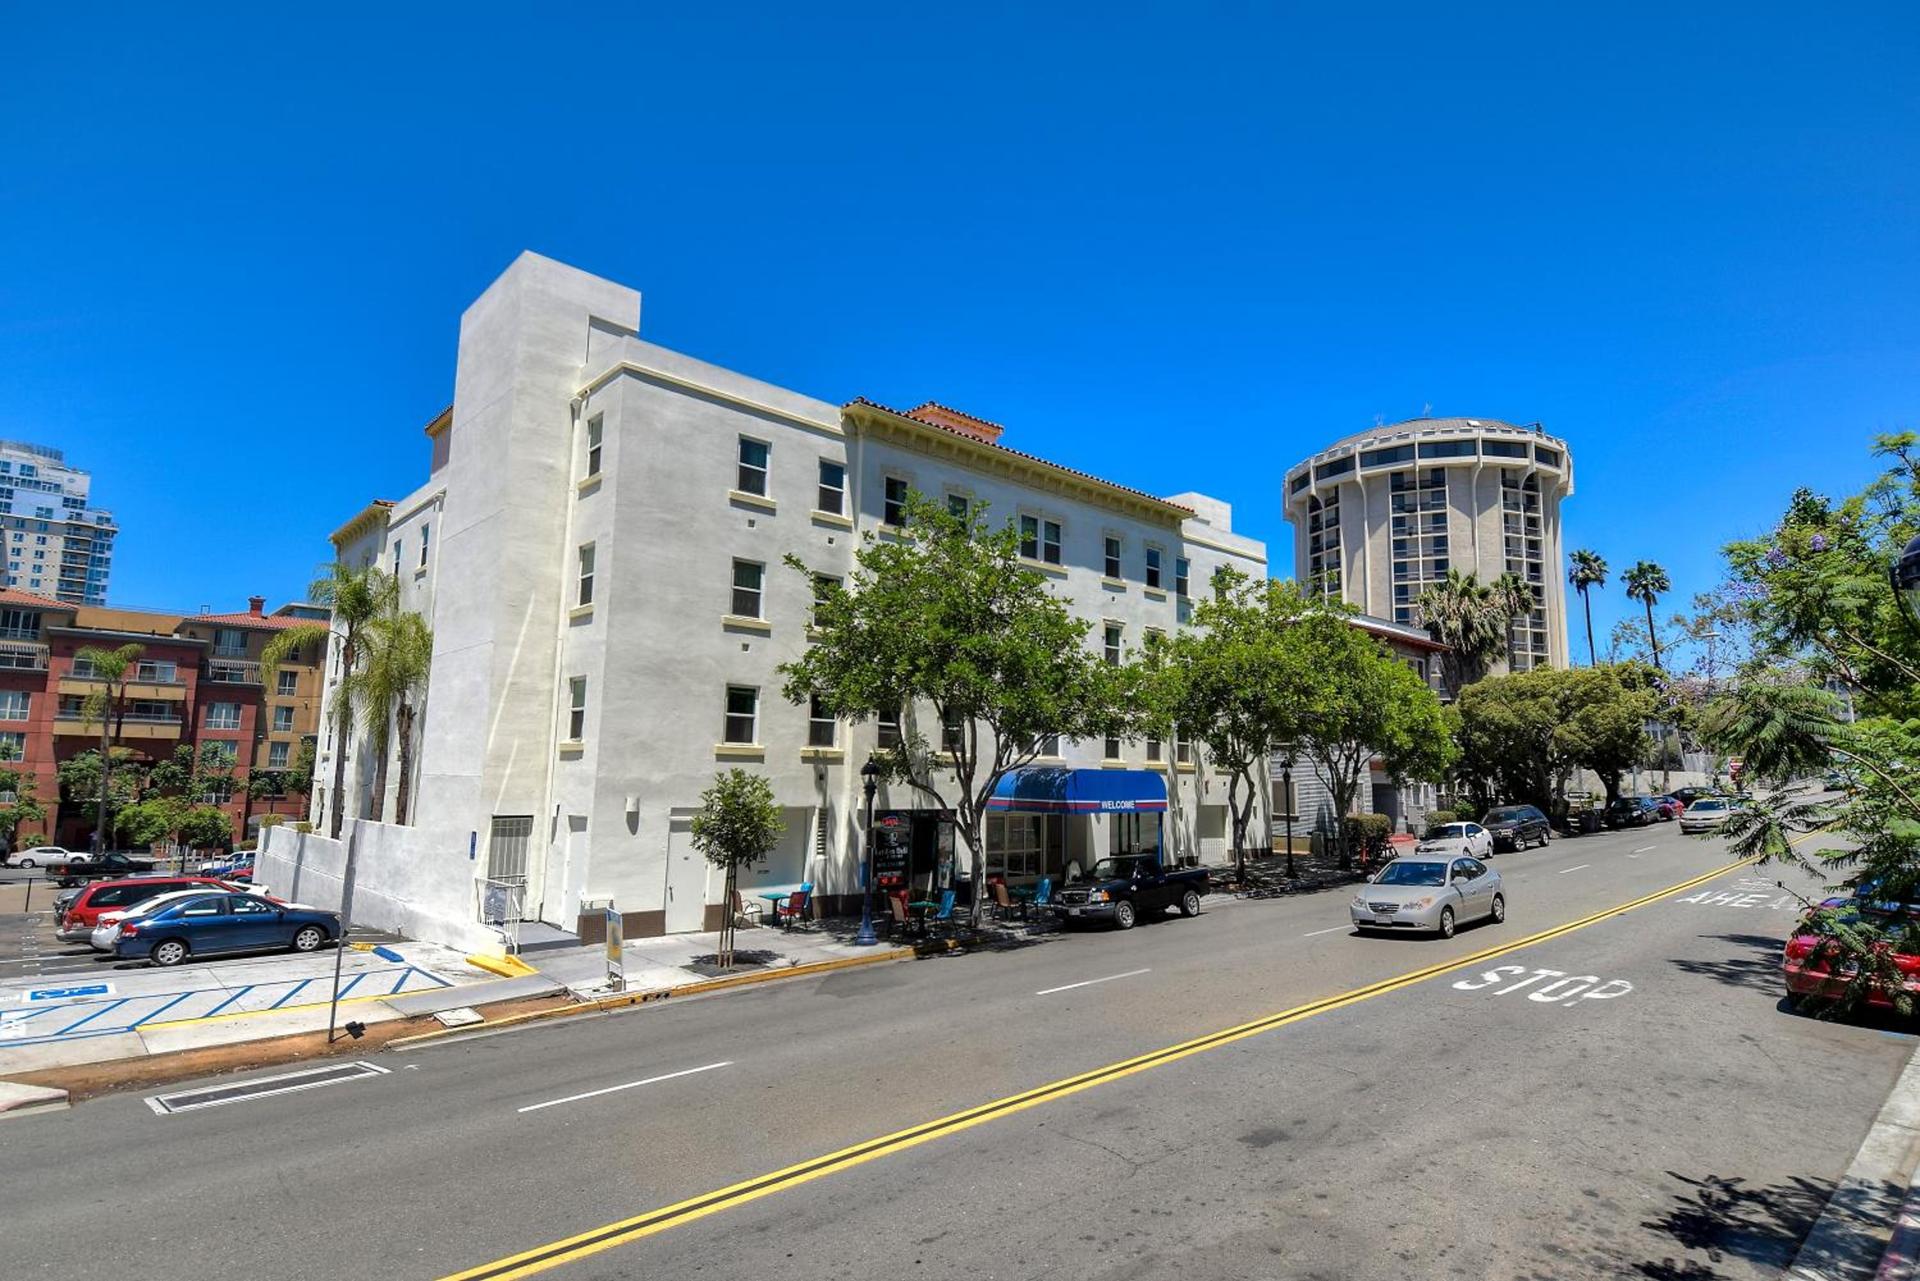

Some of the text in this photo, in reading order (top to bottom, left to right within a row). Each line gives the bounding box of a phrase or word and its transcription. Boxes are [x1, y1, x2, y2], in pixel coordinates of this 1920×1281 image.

[1101, 800, 1135, 809] WELCOME
[1675, 891, 1802, 911] AHEA
[1452, 965, 1634, 1007] STOP
